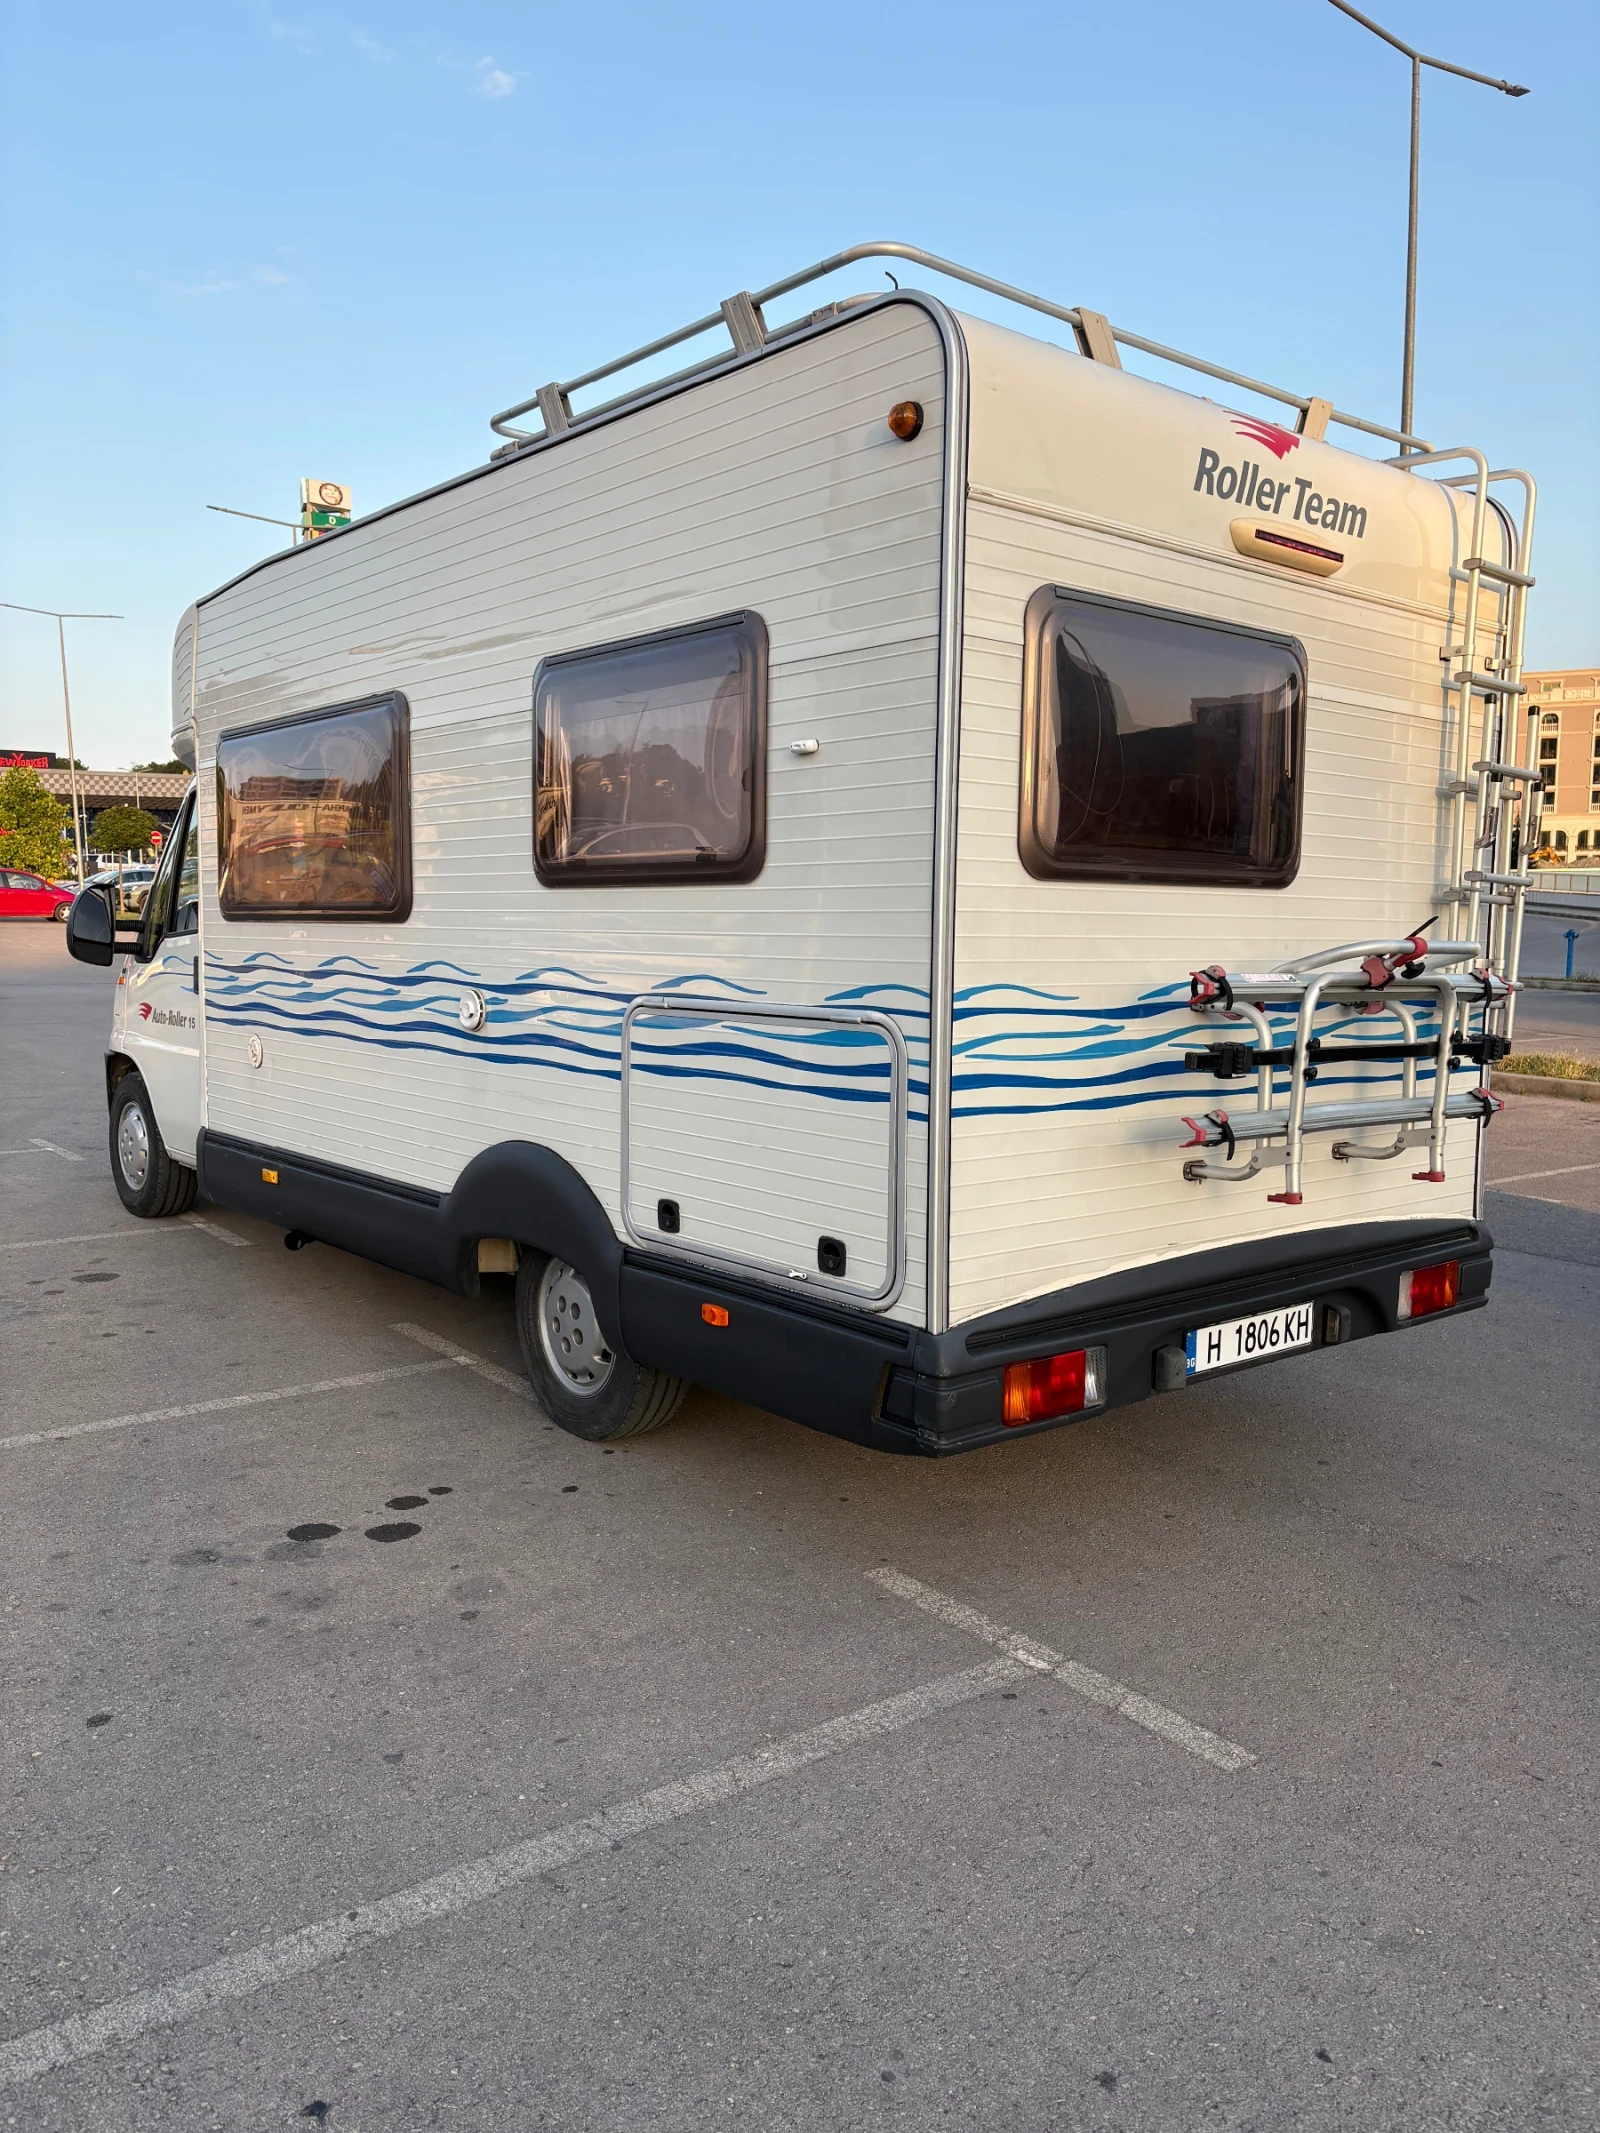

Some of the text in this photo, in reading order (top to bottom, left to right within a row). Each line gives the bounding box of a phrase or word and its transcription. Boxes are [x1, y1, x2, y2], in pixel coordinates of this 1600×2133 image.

[1193, 447, 1367, 539] Roller Team
[151, 1008, 196, 1029] Auto-Roller 15
[1207, 1308, 1309, 1364] H 1806 KH
